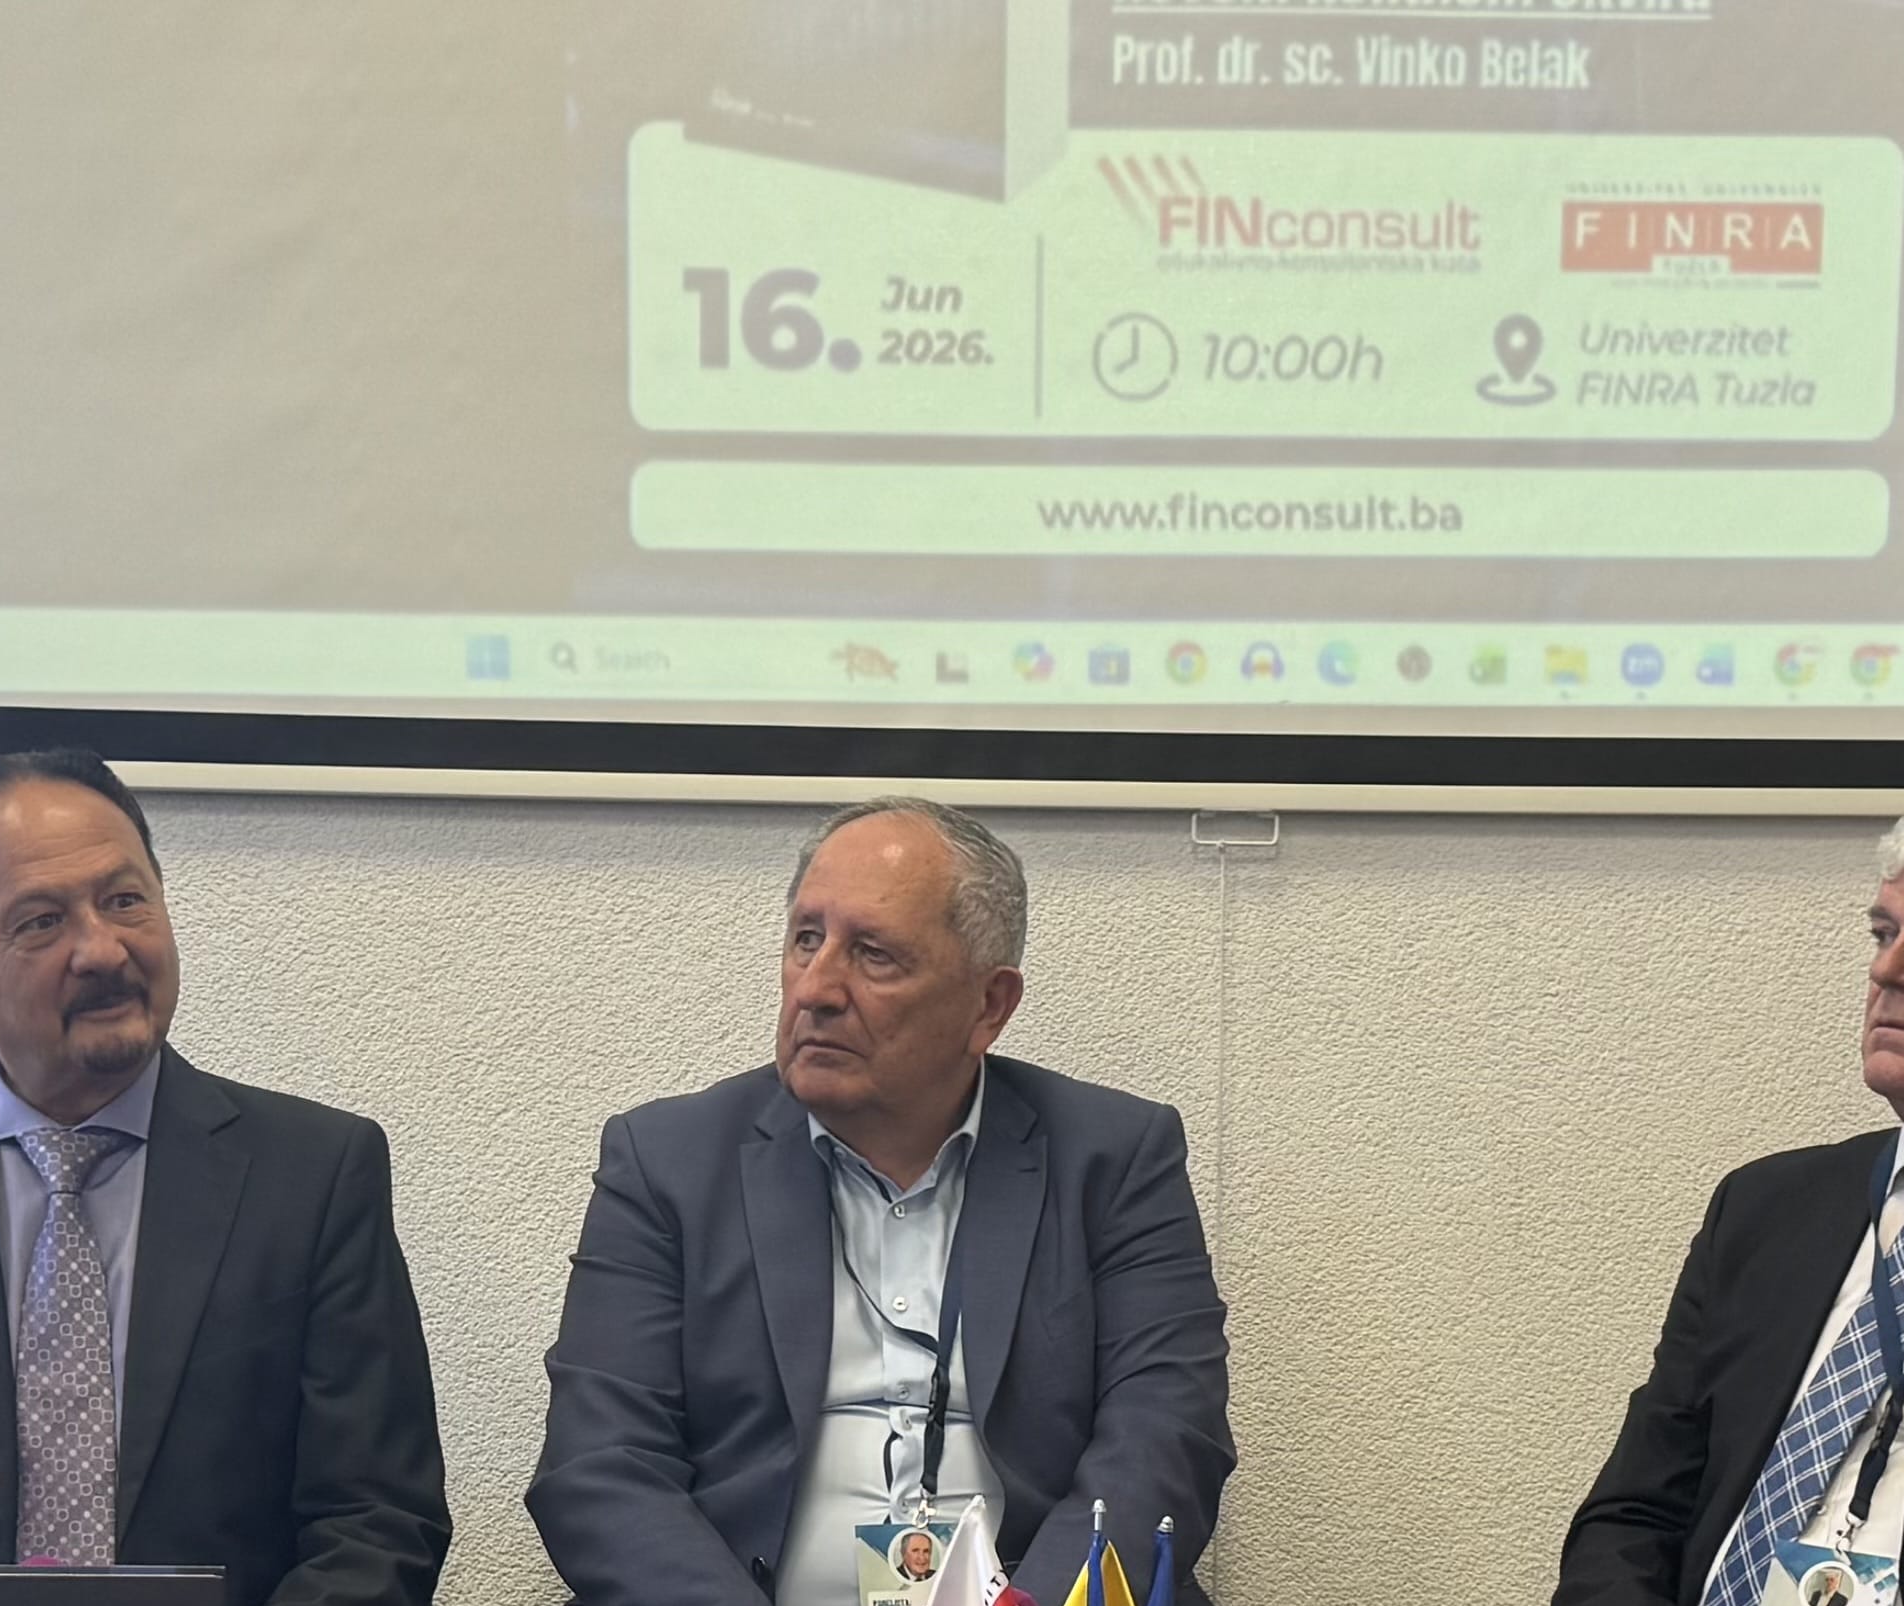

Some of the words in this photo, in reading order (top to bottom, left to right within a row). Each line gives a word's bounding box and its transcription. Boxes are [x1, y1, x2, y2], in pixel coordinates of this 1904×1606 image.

[1113, 33, 1203, 87] Prof.
[1216, 33, 1270, 86] dr.
[1283, 41, 1343, 86] sc.
[1355, 34, 1467, 87] Vinko
[1480, 36, 1590, 89] Belak
[1158, 195, 1480, 250] FINconsult
[1575, 210, 1812, 250] FINRA
[880, 273, 964, 313] Jun
[682, 267, 863, 374] 16.
[1579, 320, 1793, 357] Univerzitet
[877, 328, 995, 366] 2026.
[1202, 330, 1385, 382] 10:00h
[1577, 371, 1700, 407] FINRA
[1714, 371, 1818, 408] Tuzla
[1037, 494, 1466, 532] www.finconsult.ba
